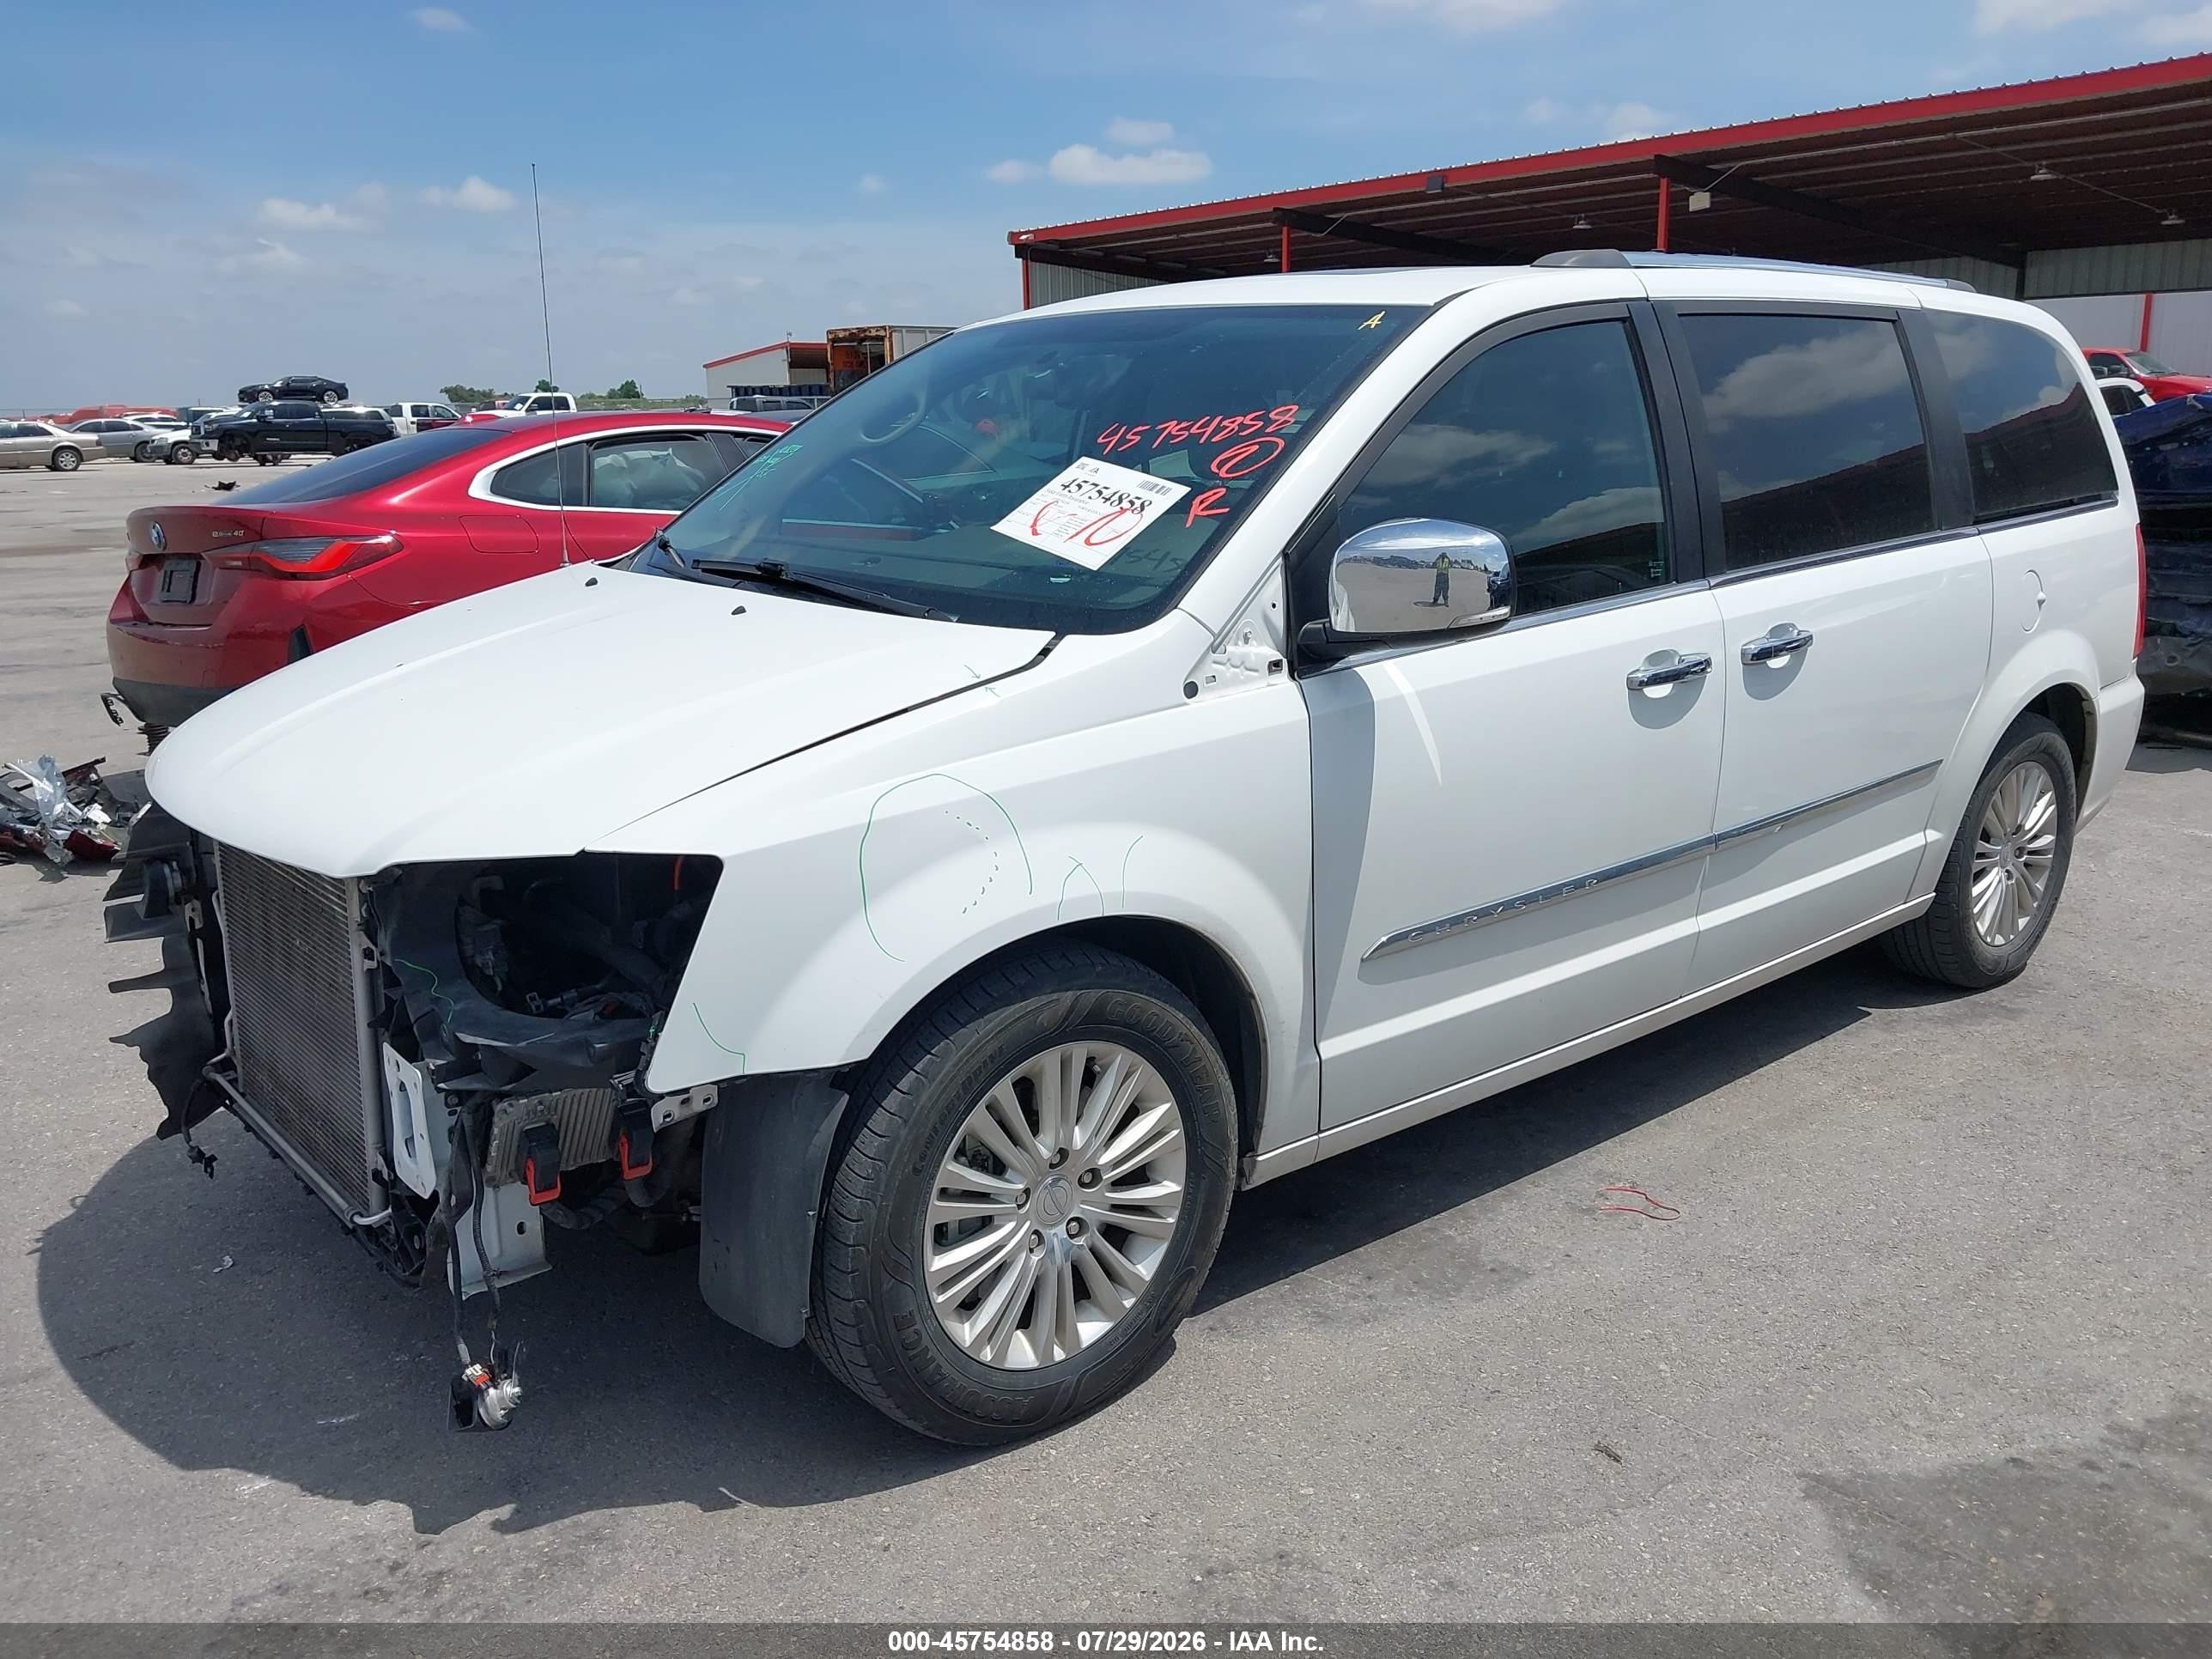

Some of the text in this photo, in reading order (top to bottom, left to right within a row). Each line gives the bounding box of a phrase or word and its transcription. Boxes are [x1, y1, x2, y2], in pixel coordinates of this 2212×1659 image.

[1097, 404, 1299, 456] 45754858
[1060, 477, 1152, 515] 45754858
[1407, 878, 1600, 943] CHRYSLER
[1106, 998, 1221, 1124] GOODYEAR
